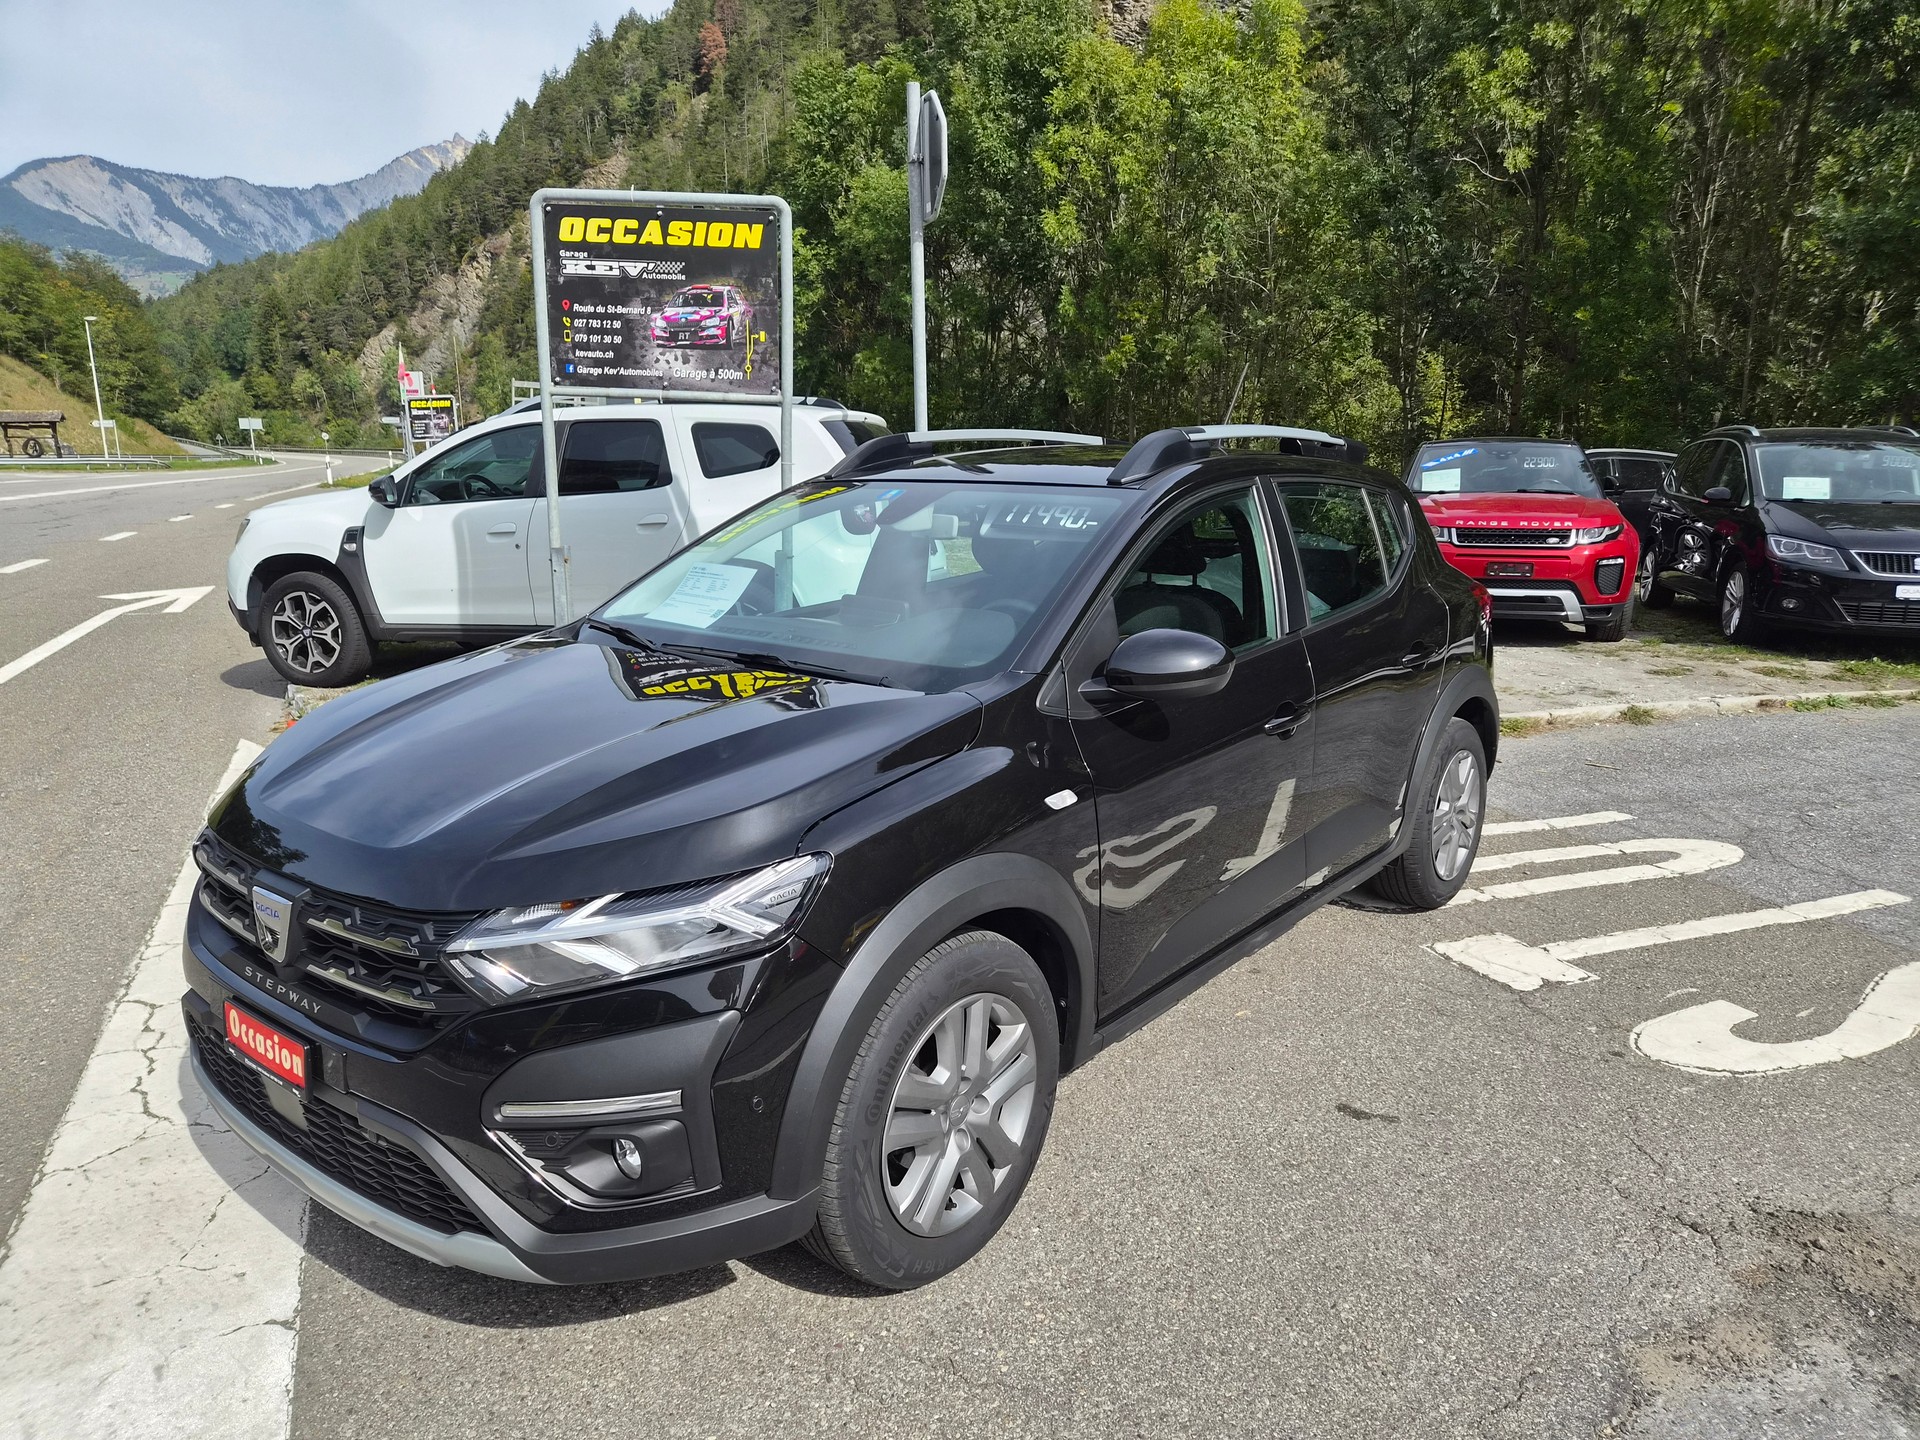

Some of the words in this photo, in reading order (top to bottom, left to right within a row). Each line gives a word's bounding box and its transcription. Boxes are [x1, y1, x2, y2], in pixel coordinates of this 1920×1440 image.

[559, 216, 764, 249] OCCASION
[559, 249, 588, 258] Garage
[642, 271, 686, 281] Automobile
[573, 303, 595, 313] Route
[596, 304, 605, 314] du
[607, 305, 645, 315] St-Bernard
[646, 306, 652, 315] 8
[573, 319, 587, 328] 027
[588, 319, 601, 328] 783
[602, 320, 612, 328] 12
[612, 320, 622, 329] 50
[574, 334, 588, 343] 079
[588, 334, 601, 343] 101
[603, 335, 612, 344] 30
[613, 335, 622, 344] 50
[678, 332, 691, 340] RT
[575, 348, 615, 359] kevauto.ch
[576, 365, 603, 376] Garage
[603, 366, 664, 377] Kev'Automobiles
[673, 367, 707, 380] Garage
[709, 368, 716, 379] à
[717, 368, 744, 380] 500m
[410, 400, 450, 408] OCCASION
[769, 888, 797, 903] DACIA
[255, 901, 281, 920] DACIA
[244, 966, 322, 1014] STEPWAY
[228, 1008, 303, 1078] Occasion
[864, 1002, 929, 1127] Continental
